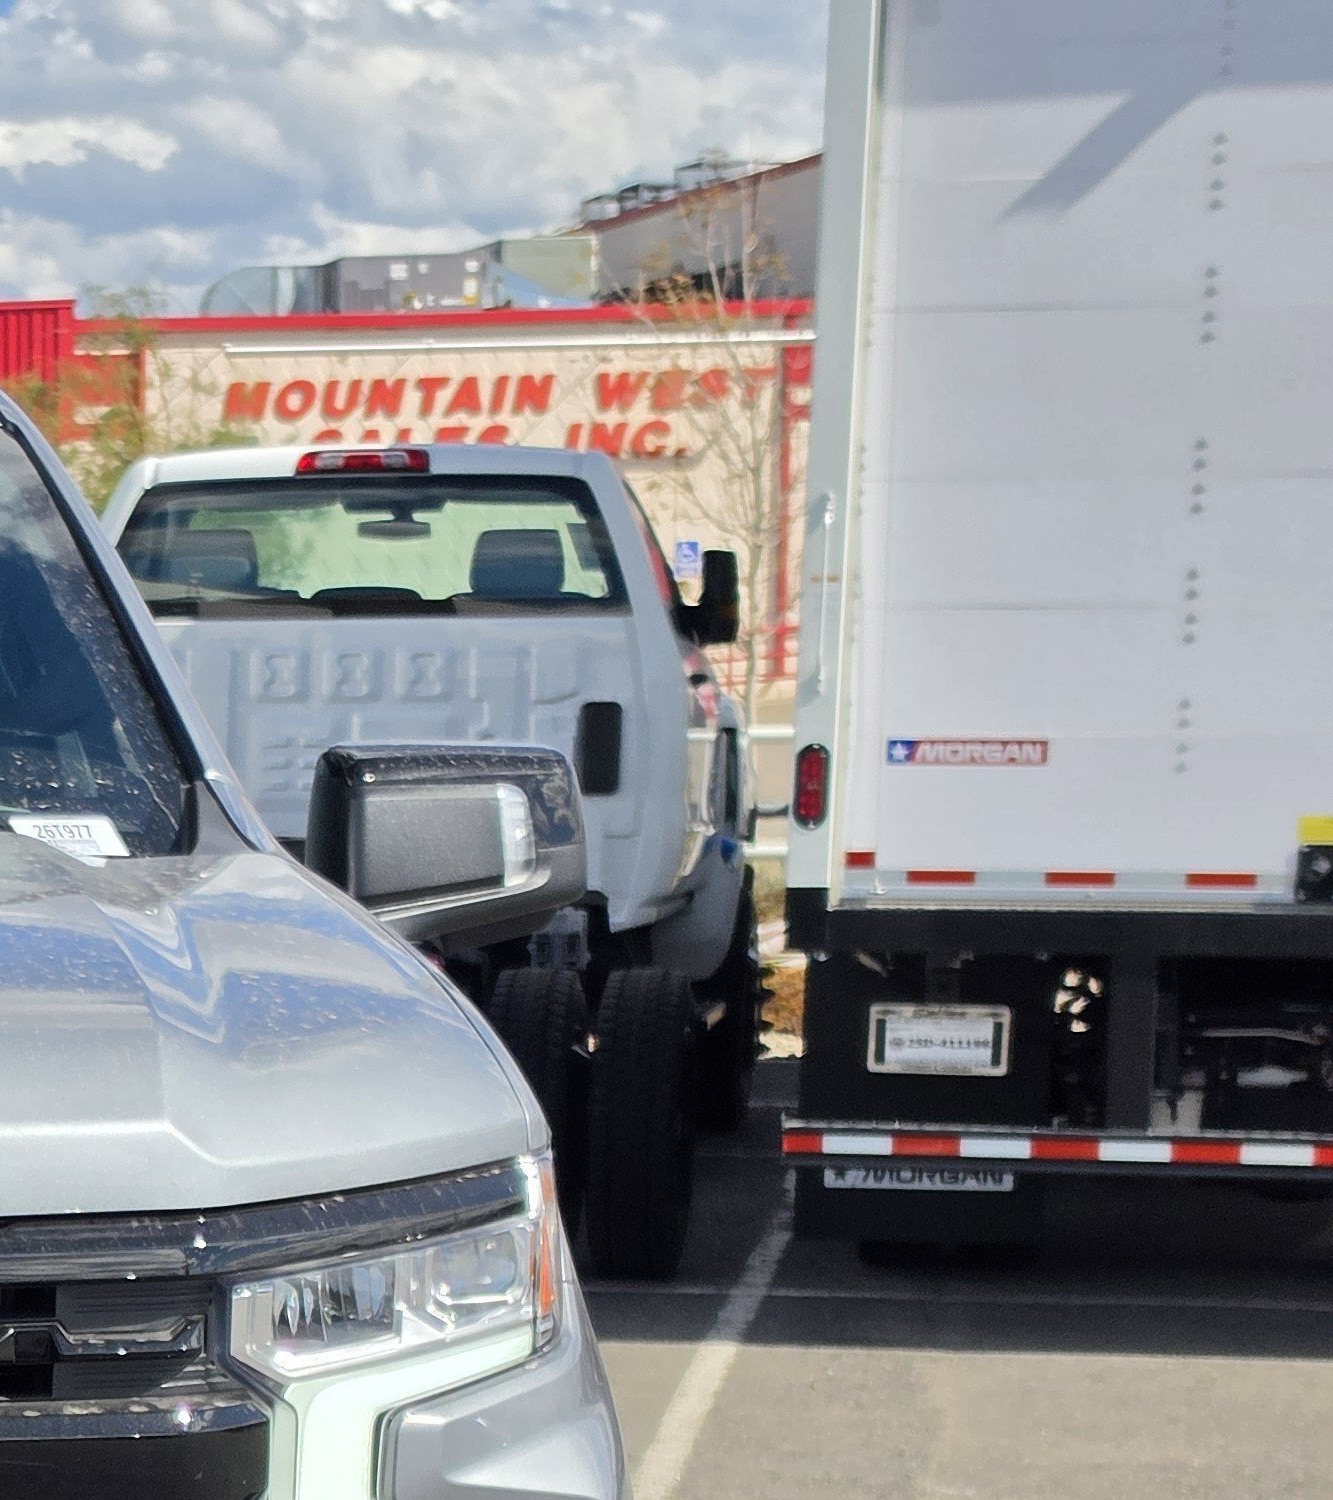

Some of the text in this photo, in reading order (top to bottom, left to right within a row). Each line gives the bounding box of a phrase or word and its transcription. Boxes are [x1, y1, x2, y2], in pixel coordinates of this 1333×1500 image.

[223, 374, 555, 423] MOUNTAIN
[914, 741, 1043, 764] MORGAN
[32, 824, 93, 839] 26T977
